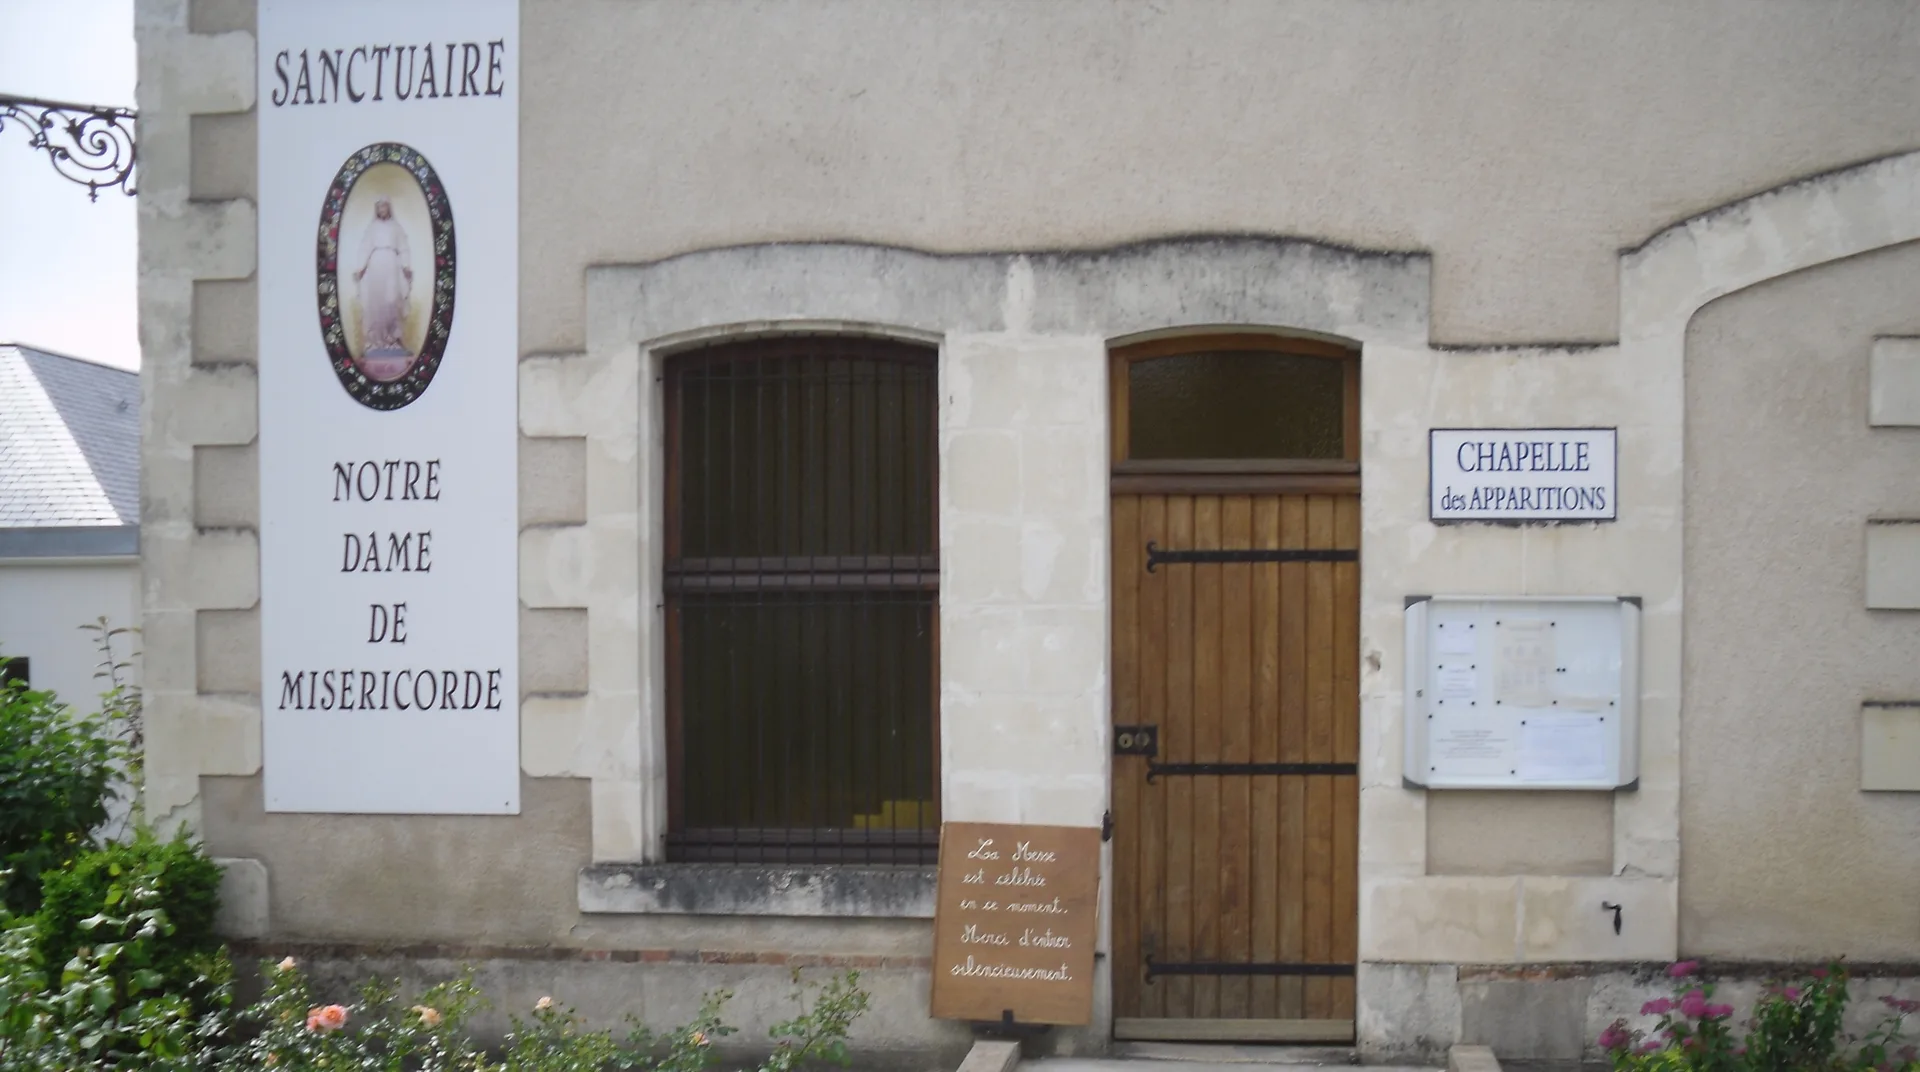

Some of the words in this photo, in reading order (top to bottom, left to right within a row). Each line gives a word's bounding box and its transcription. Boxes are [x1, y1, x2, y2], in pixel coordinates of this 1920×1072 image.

[272, 38, 505, 107] SANCTUAIRE
[1457, 441, 1590, 472] CHAPELLE
[332, 458, 441, 502] NOTRE
[1441, 487, 1467, 511] des
[1468, 486, 1606, 511] APPARITIONS
[340, 529, 432, 573] DAME
[367, 602, 407, 645] DE
[278, 668, 502, 711] MISERICORDE
[967, 838, 1000, 860] La
[1011, 840, 1056, 863] Messe
[961, 867, 985, 885] est
[959, 898, 977, 910] en
[982, 900, 999, 911] ce
[1006, 896, 1069, 914] moment.
[960, 924, 1010, 946] Merci
[1018, 928, 1072, 949] d'entrer
[951, 954, 1073, 981] silencieusement.
